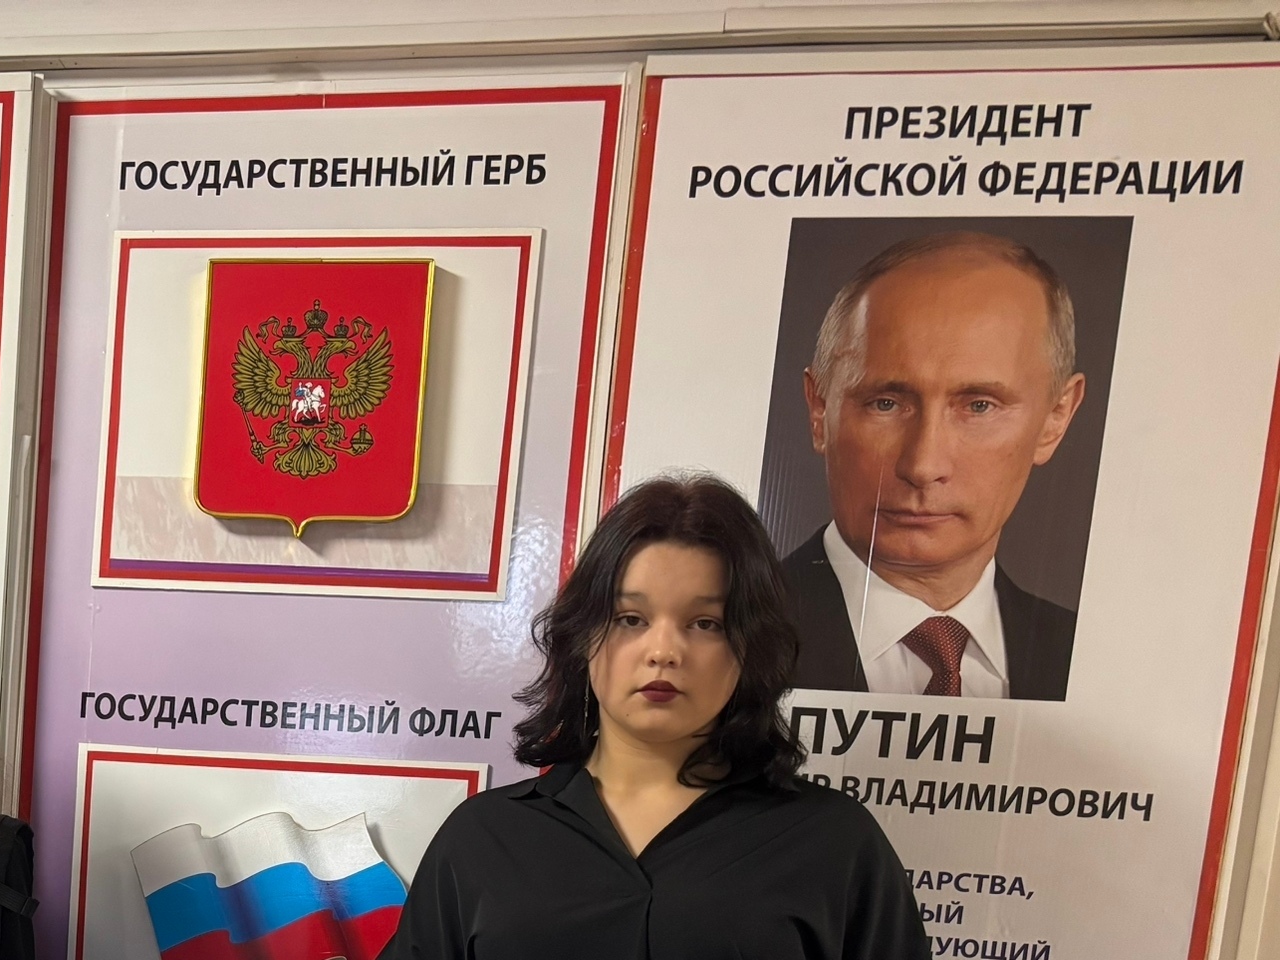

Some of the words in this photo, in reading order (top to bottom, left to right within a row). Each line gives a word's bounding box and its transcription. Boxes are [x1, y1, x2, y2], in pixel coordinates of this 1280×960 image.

[844, 103, 1092, 146] ПРЕЗИДЕНТ
[119, 149, 455, 196] ГОСУДАРСТВЕННЫЙ
[464, 153, 547, 187] ГЕРБ
[688, 155, 968, 199] РОССИЙСКОЙ
[978, 159, 1244, 204] ФЕДЕРАЦИИ
[80, 691, 401, 735] ГОСУДАРСТВЕННЫЙ
[409, 706, 501, 739] ФЛАГ
[790, 706, 996, 764] ПУТИН
[841, 775, 1154, 822] ВЛАДИМИРОВИЧ
